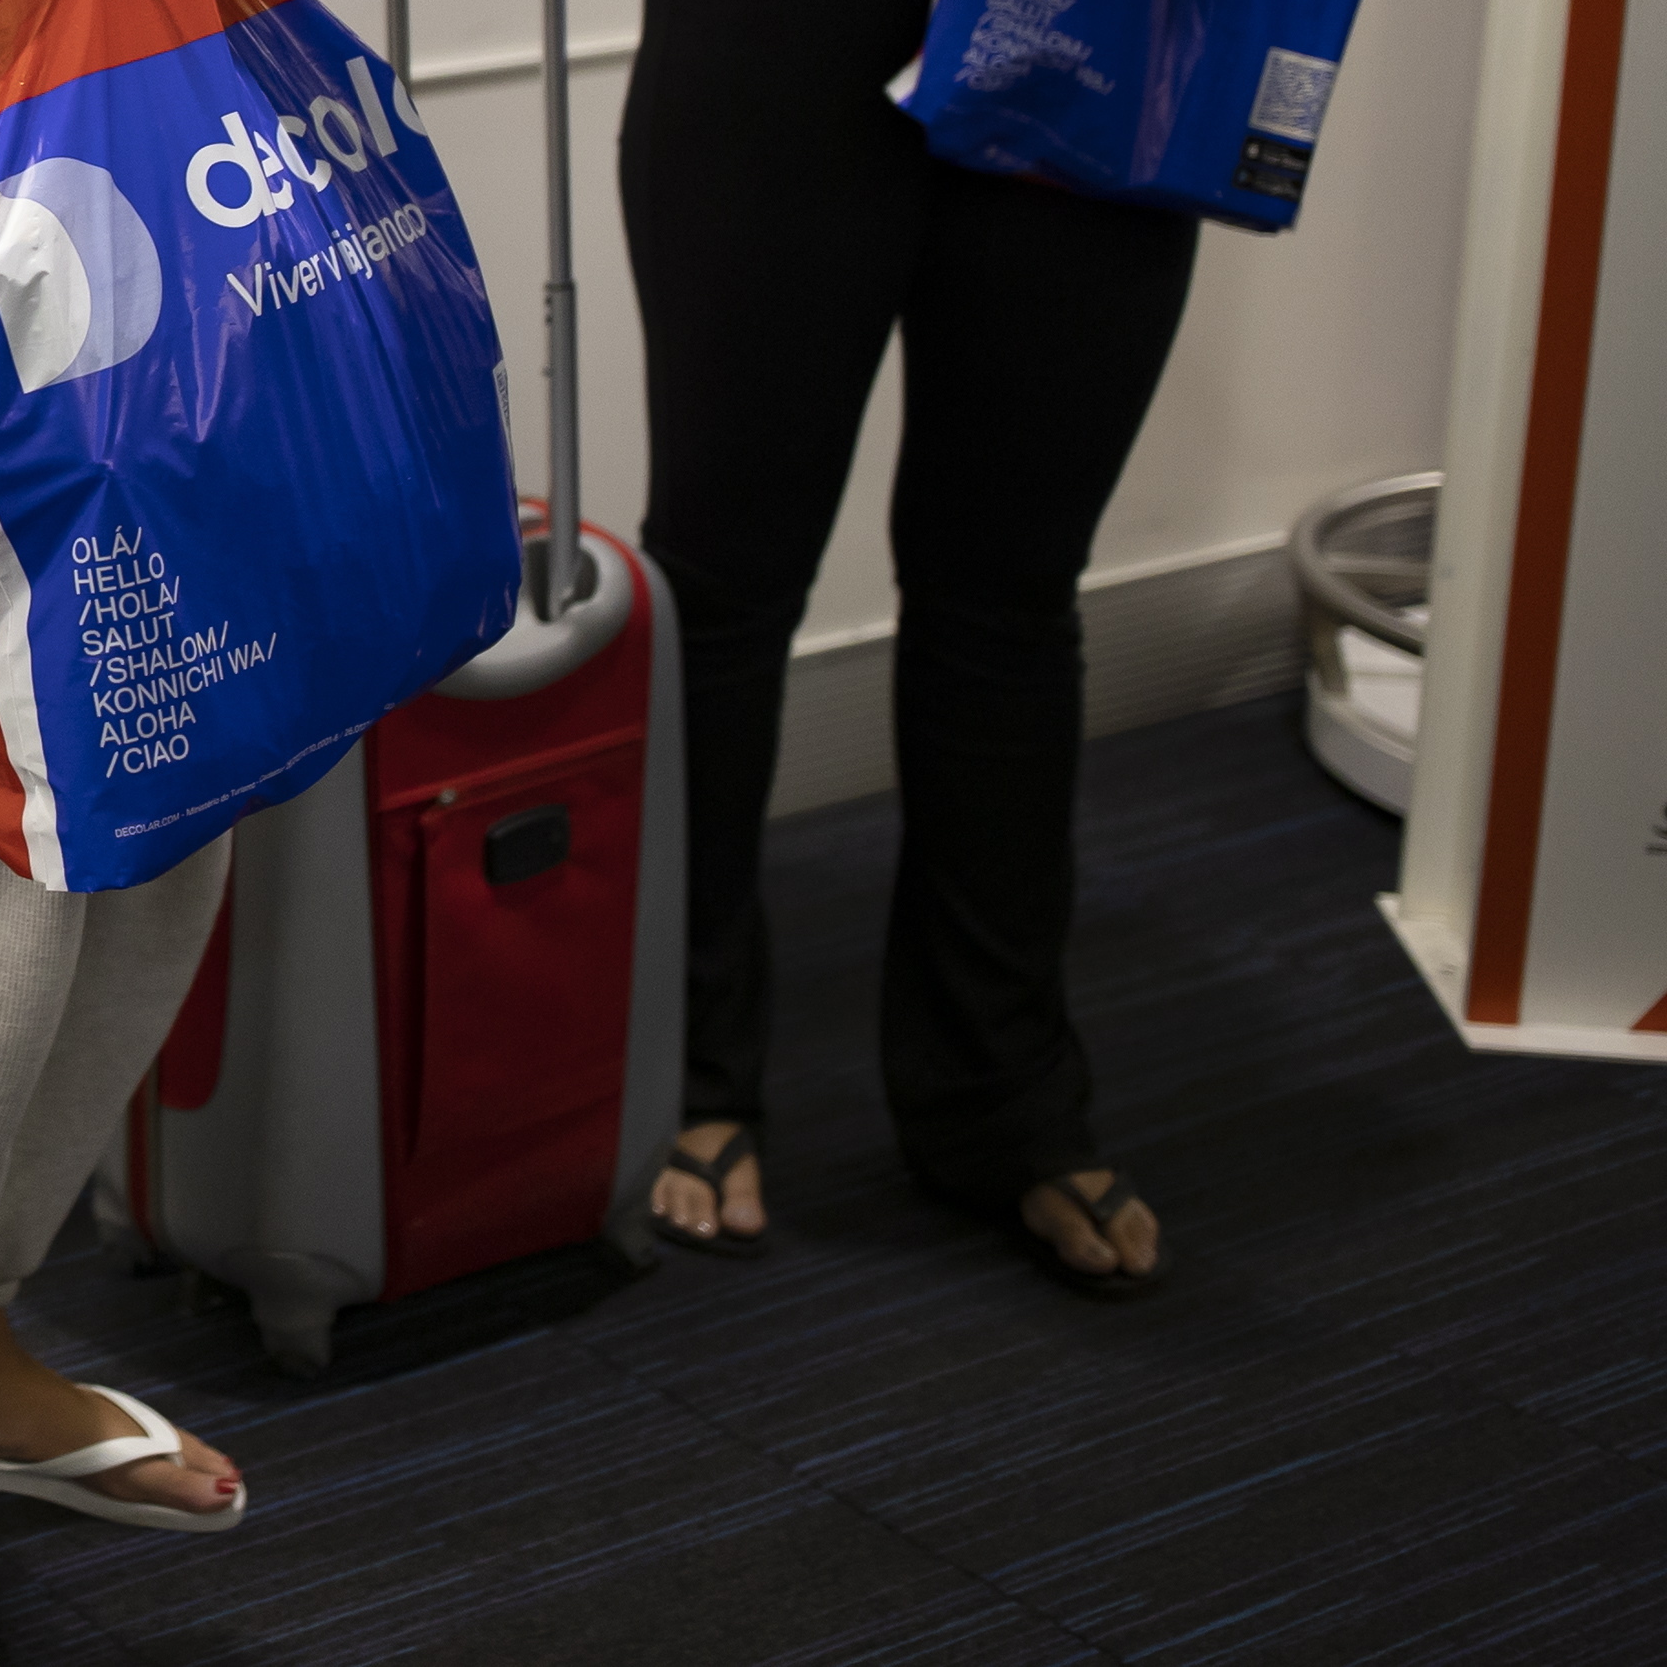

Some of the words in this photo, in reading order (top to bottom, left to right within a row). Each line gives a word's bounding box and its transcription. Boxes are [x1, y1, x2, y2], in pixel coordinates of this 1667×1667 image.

[226, 253, 326, 317] Viver
[71, 526, 142, 565] OLÁ/
[73, 552, 165, 596] HELLO
[78, 576, 180, 626] /HOLA/
[81, 611, 175, 656] SALUT
[89, 620, 229, 687] /SHALOM/
[92, 661, 225, 718] KONNICHI
[227, 632, 277, 676] WA/
[99, 700, 197, 749] ALOHA
[105, 734, 190, 779] /CIAO
[114, 812, 180, 838] DECOLAR.COM
